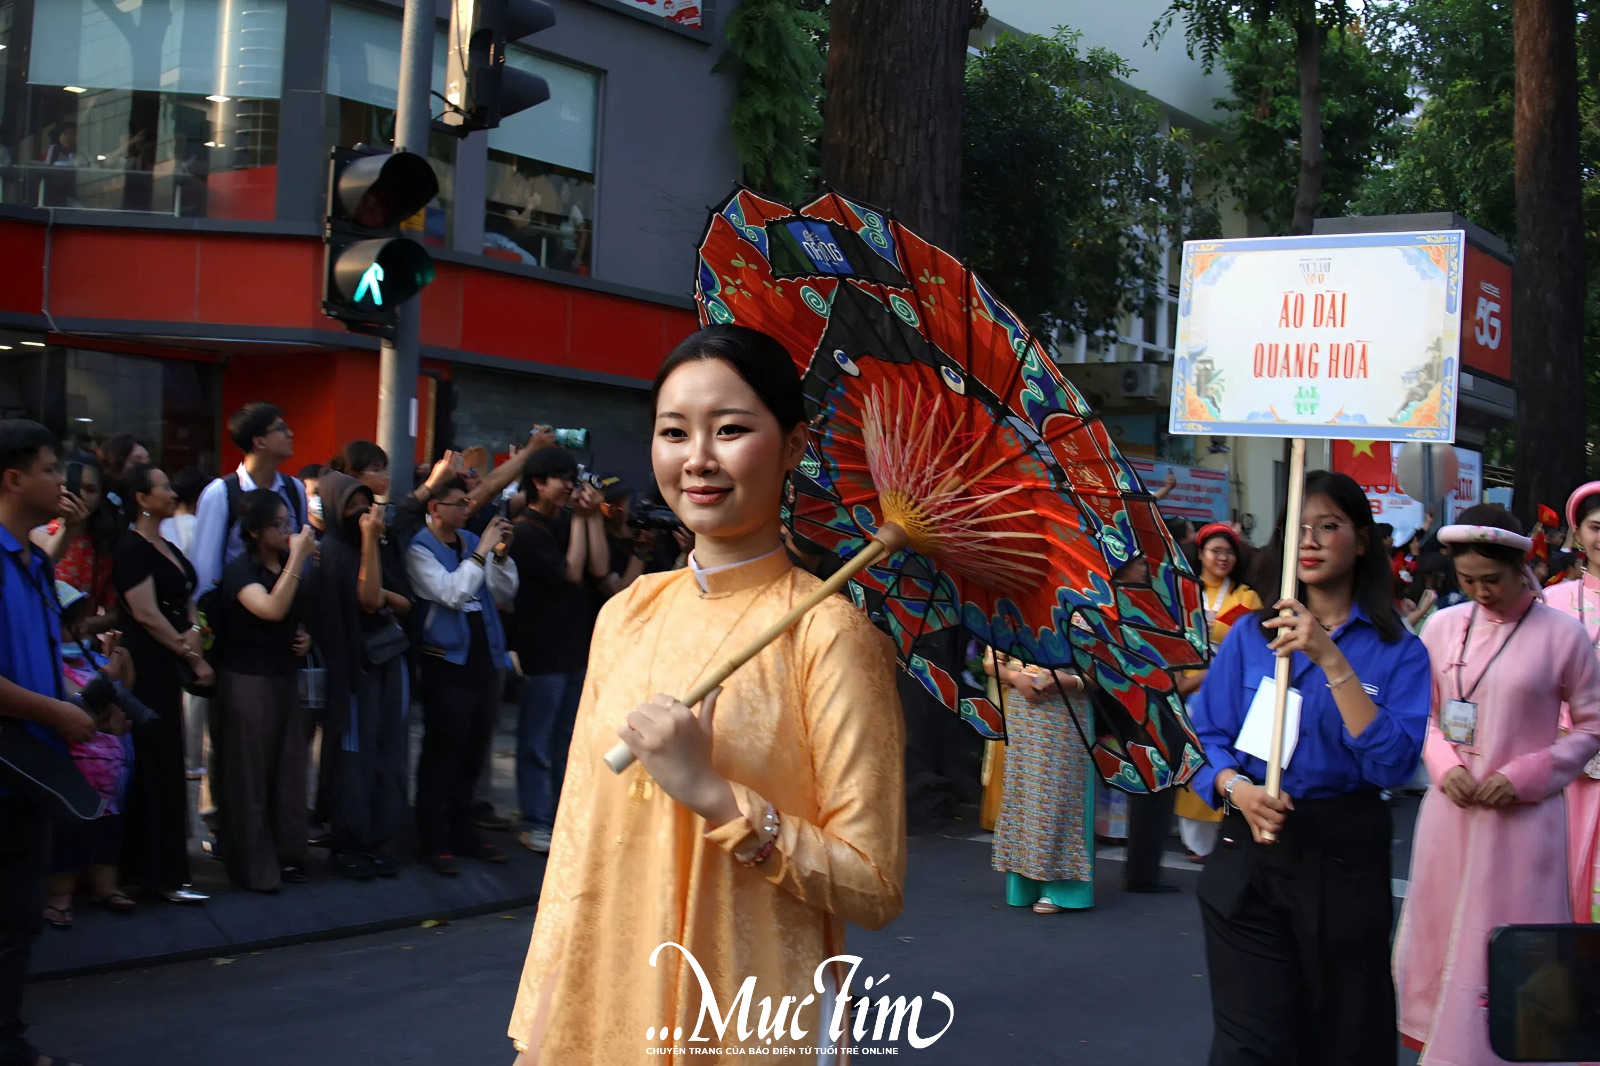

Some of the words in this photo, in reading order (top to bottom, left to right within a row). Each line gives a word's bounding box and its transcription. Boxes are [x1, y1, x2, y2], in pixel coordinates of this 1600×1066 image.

[1278, 290, 1305, 328] ÁO
[1313, 289, 1347, 328] DÀI
[1474, 295, 1501, 350] 5G
[1253, 342, 1319, 379] QUANG
